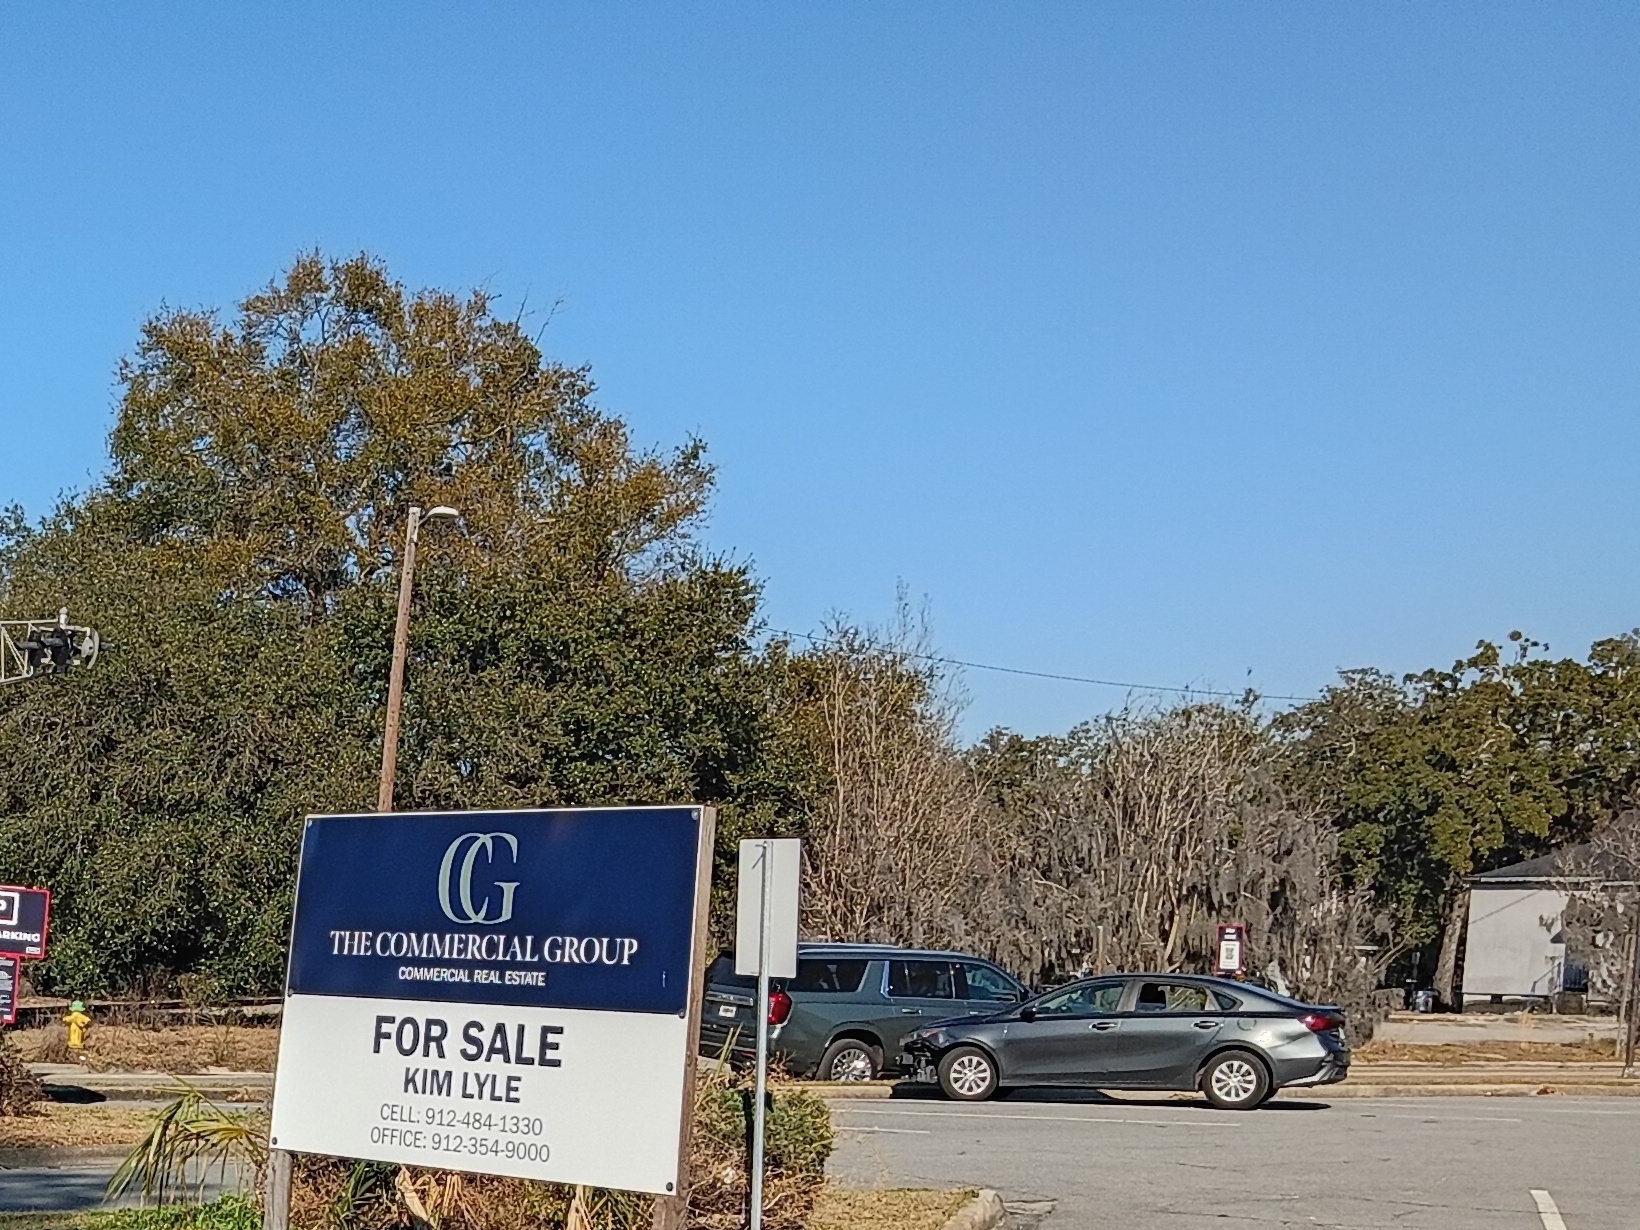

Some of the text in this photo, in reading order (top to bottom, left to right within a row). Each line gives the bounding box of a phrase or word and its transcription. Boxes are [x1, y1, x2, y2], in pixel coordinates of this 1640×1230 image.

[330, 930, 639, 965] THE COMMERCIAL GROUP
[398, 966, 547, 987] COMMERCIAL REAL ESTATE
[373, 1015, 564, 1068] FOR SALE
[403, 1066, 523, 1104] KIM LYLE
[380, 1103, 543, 1136] CELL: 912-484-1330
[370, 1126, 551, 1163] OFFICE: 912-354-9000
